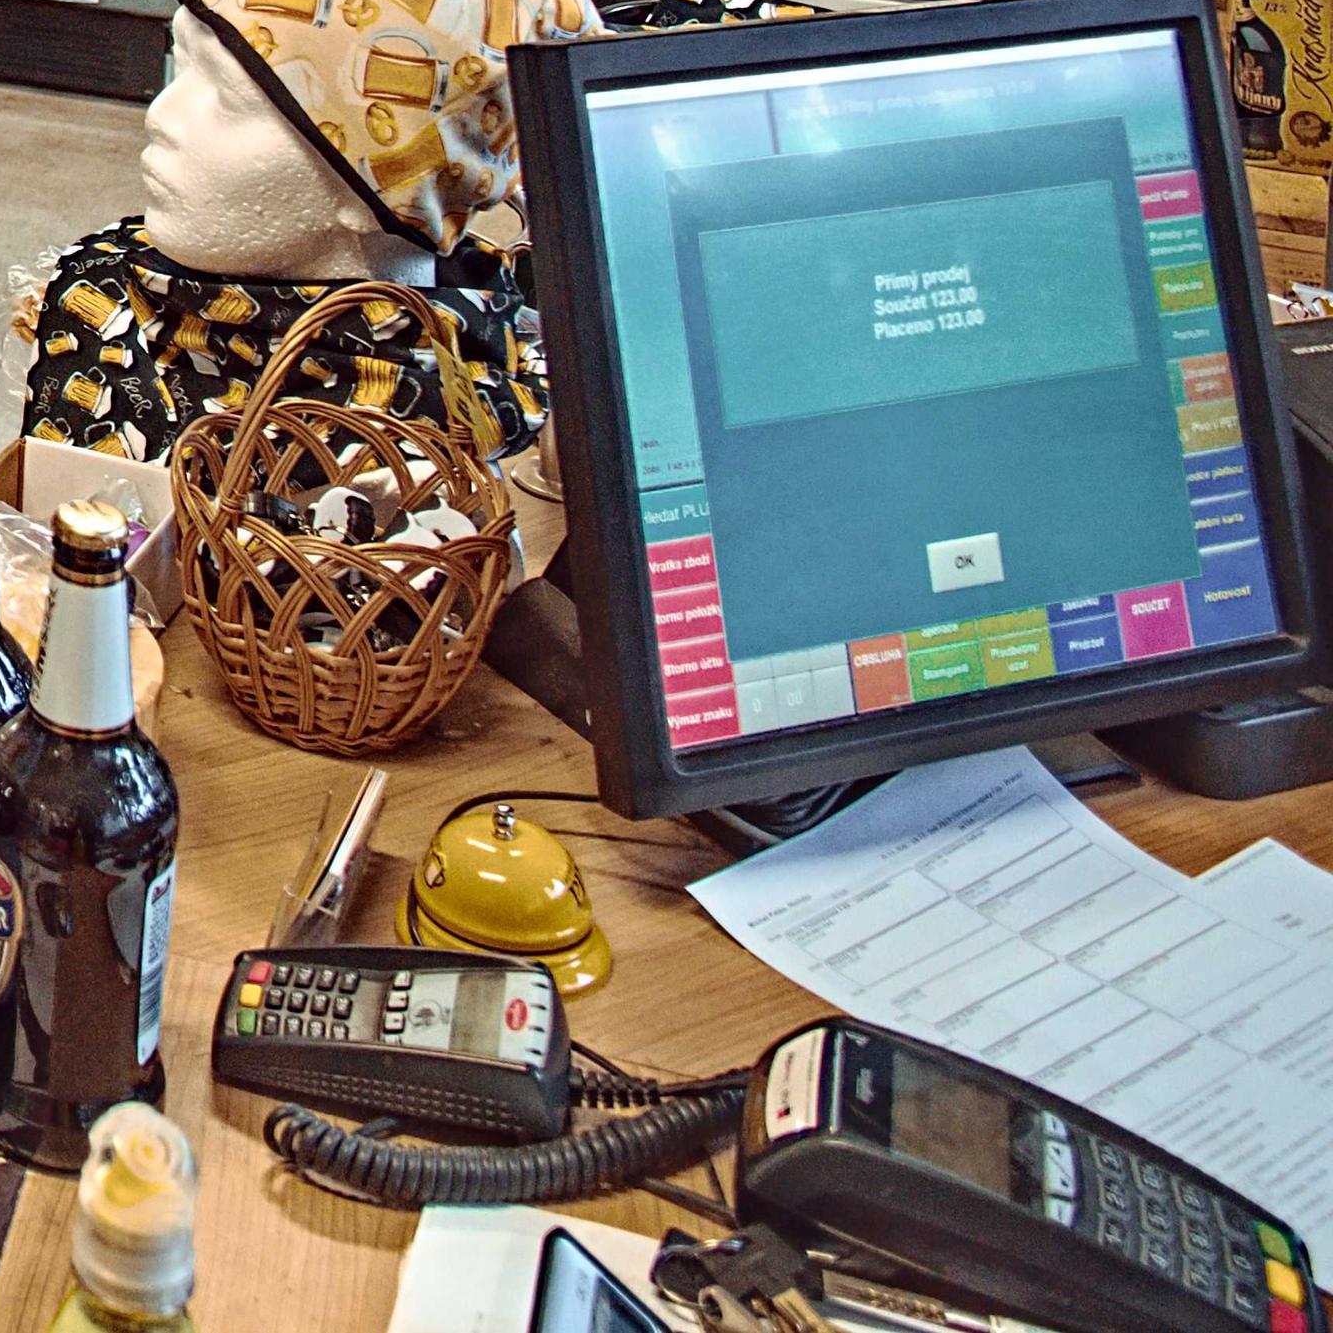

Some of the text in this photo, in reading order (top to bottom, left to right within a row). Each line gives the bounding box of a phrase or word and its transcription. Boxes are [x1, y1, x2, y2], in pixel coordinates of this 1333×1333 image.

[874, 264, 971, 292] Přímý prodej
[874, 295, 927, 317] Součet
[873, 320, 934, 340] Placeno
[649, 552, 711, 573] Vratka zboží
[954, 553, 975, 569] OK
[663, 659, 696, 677] Storno
[667, 706, 733, 729] Výmaz znaku
